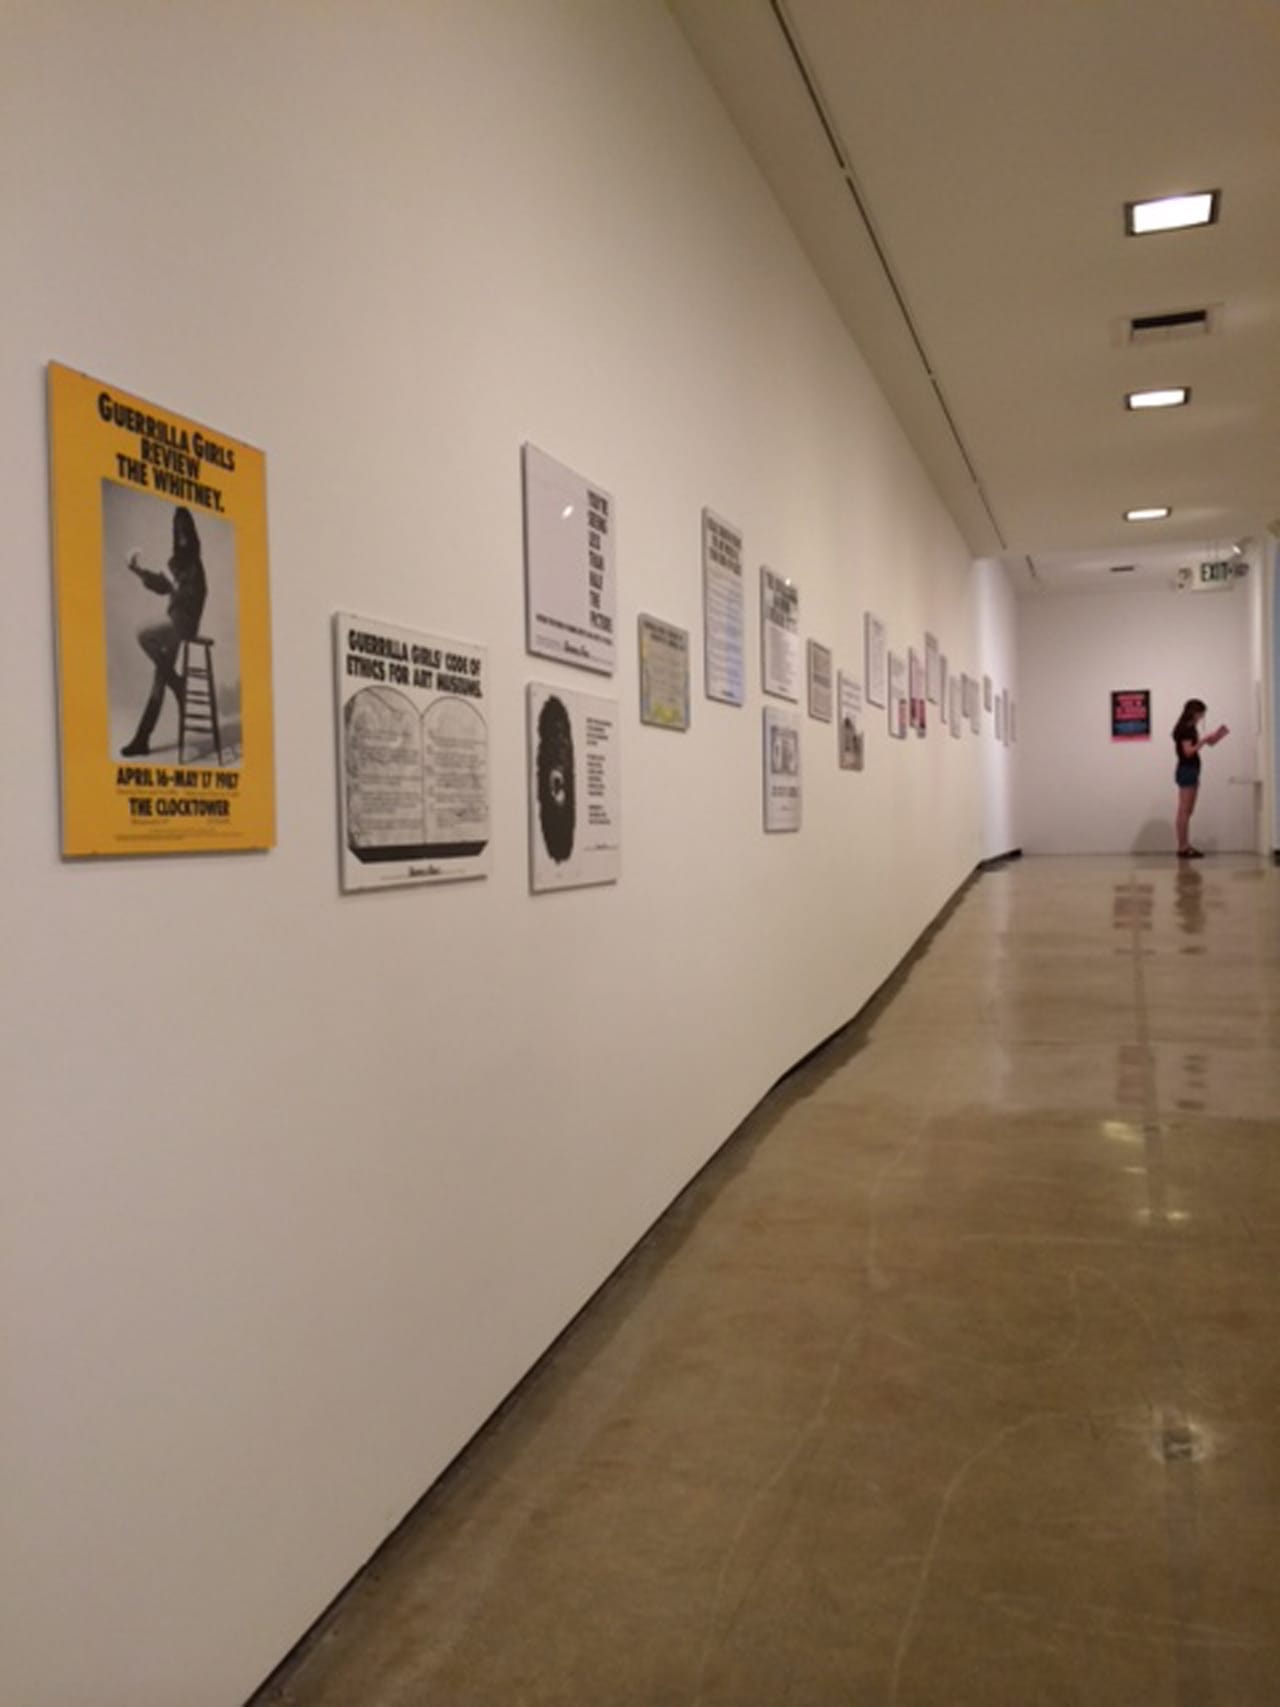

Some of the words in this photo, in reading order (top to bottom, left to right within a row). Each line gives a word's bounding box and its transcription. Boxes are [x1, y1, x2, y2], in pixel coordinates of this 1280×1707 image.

[97, 392, 190, 453] GUERRILLA
[192, 432, 236, 471] GIRLS
[140, 438, 200, 480] REVIEW
[116, 453, 148, 486] THE
[152, 467, 225, 513] WHITNEY.
[1201, 562, 1228, 582] EXIT
[348, 629, 408, 661] GUERRILLA
[346, 653, 385, 682] ETHICS
[389, 662, 410, 685] FOR
[413, 668, 433, 689] ART
[116, 768, 154, 786] APRIL
[128, 798, 153, 816] THE
